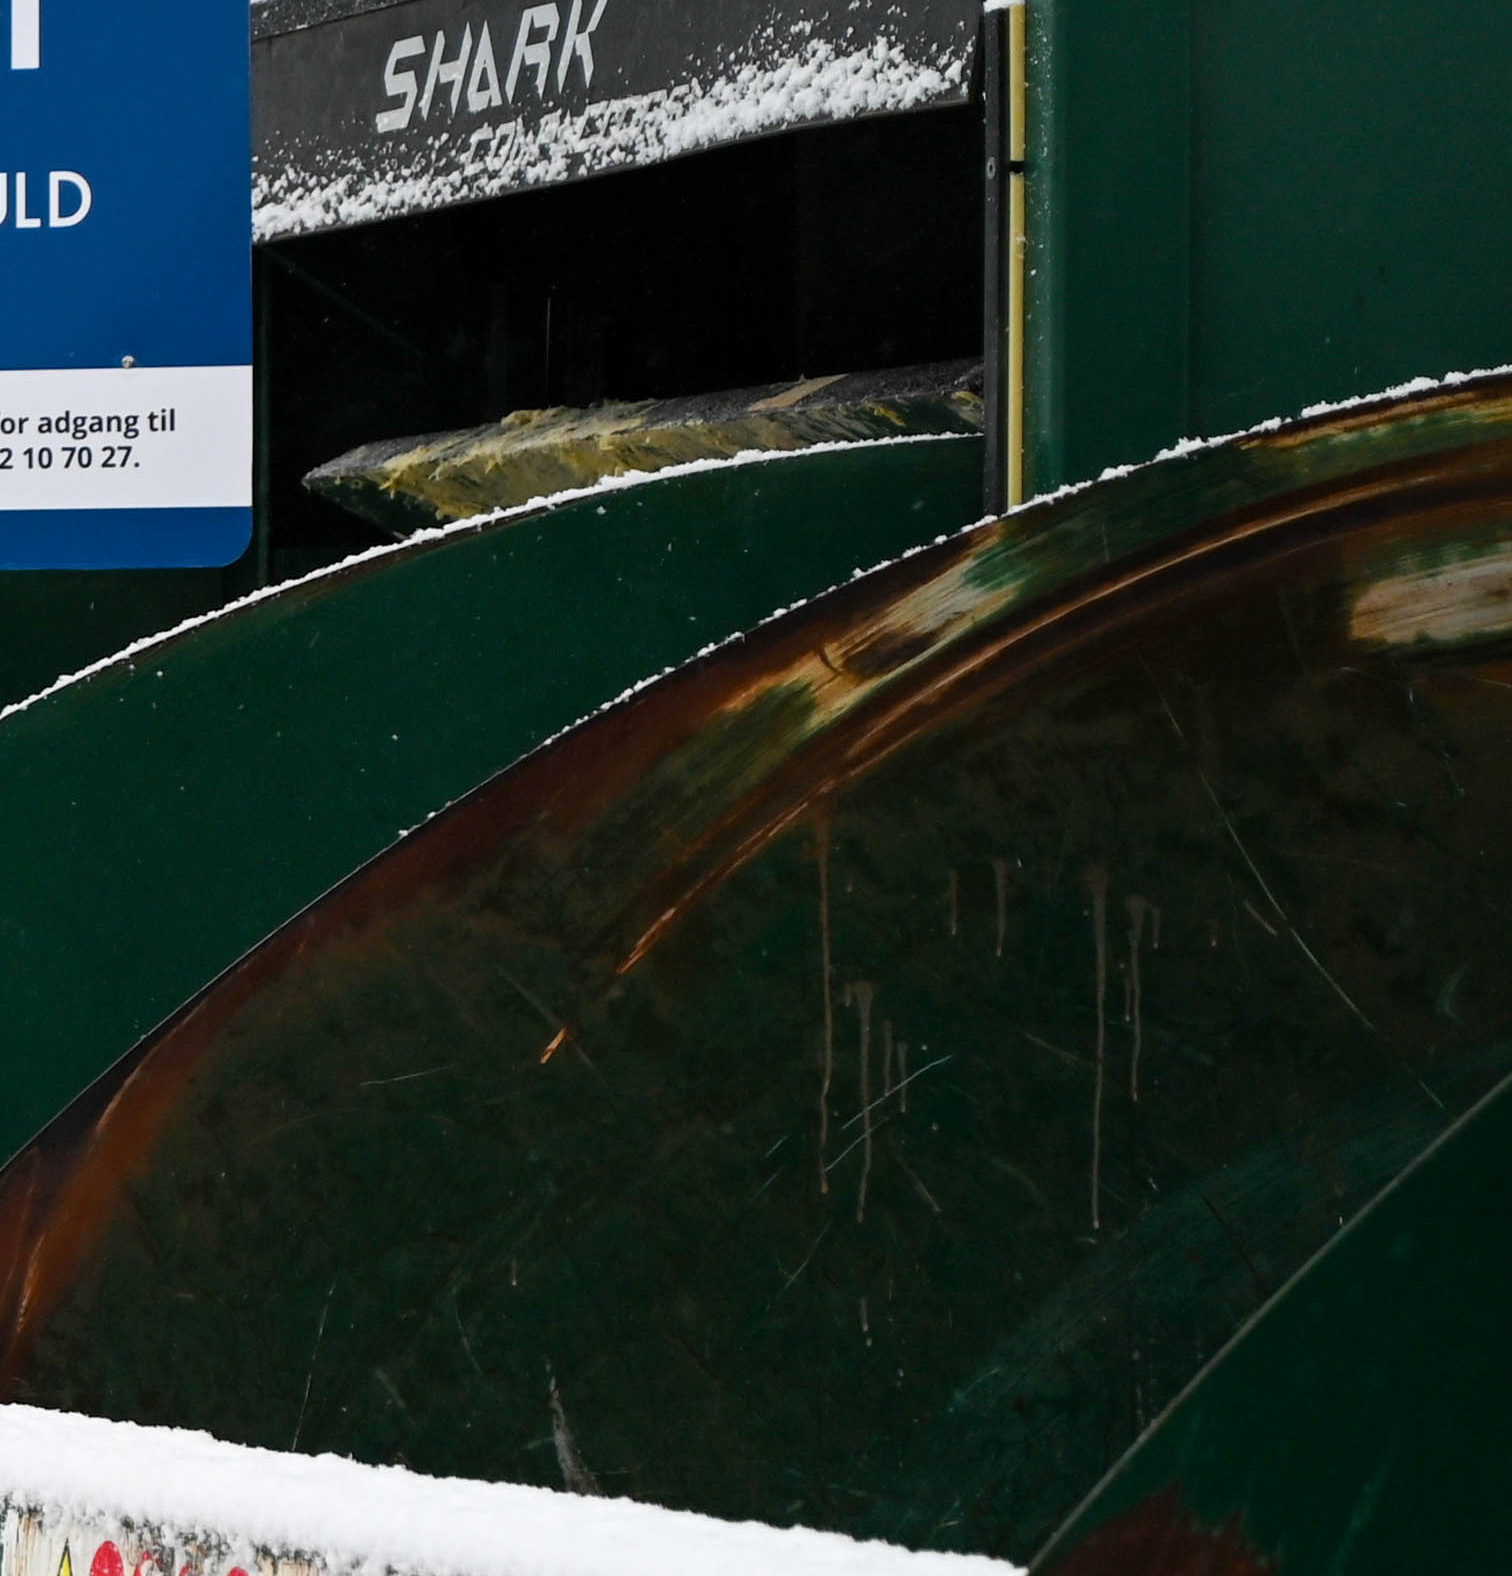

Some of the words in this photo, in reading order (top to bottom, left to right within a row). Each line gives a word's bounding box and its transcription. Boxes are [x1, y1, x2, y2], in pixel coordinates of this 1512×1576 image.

[376, 0, 606, 133] SHARK
[38, 411, 139, 440] adgang
[148, 409, 174, 431] til
[24, 448, 52, 469] 10
[62, 447, 92, 468] 70
[102, 446, 139, 467] 27.
